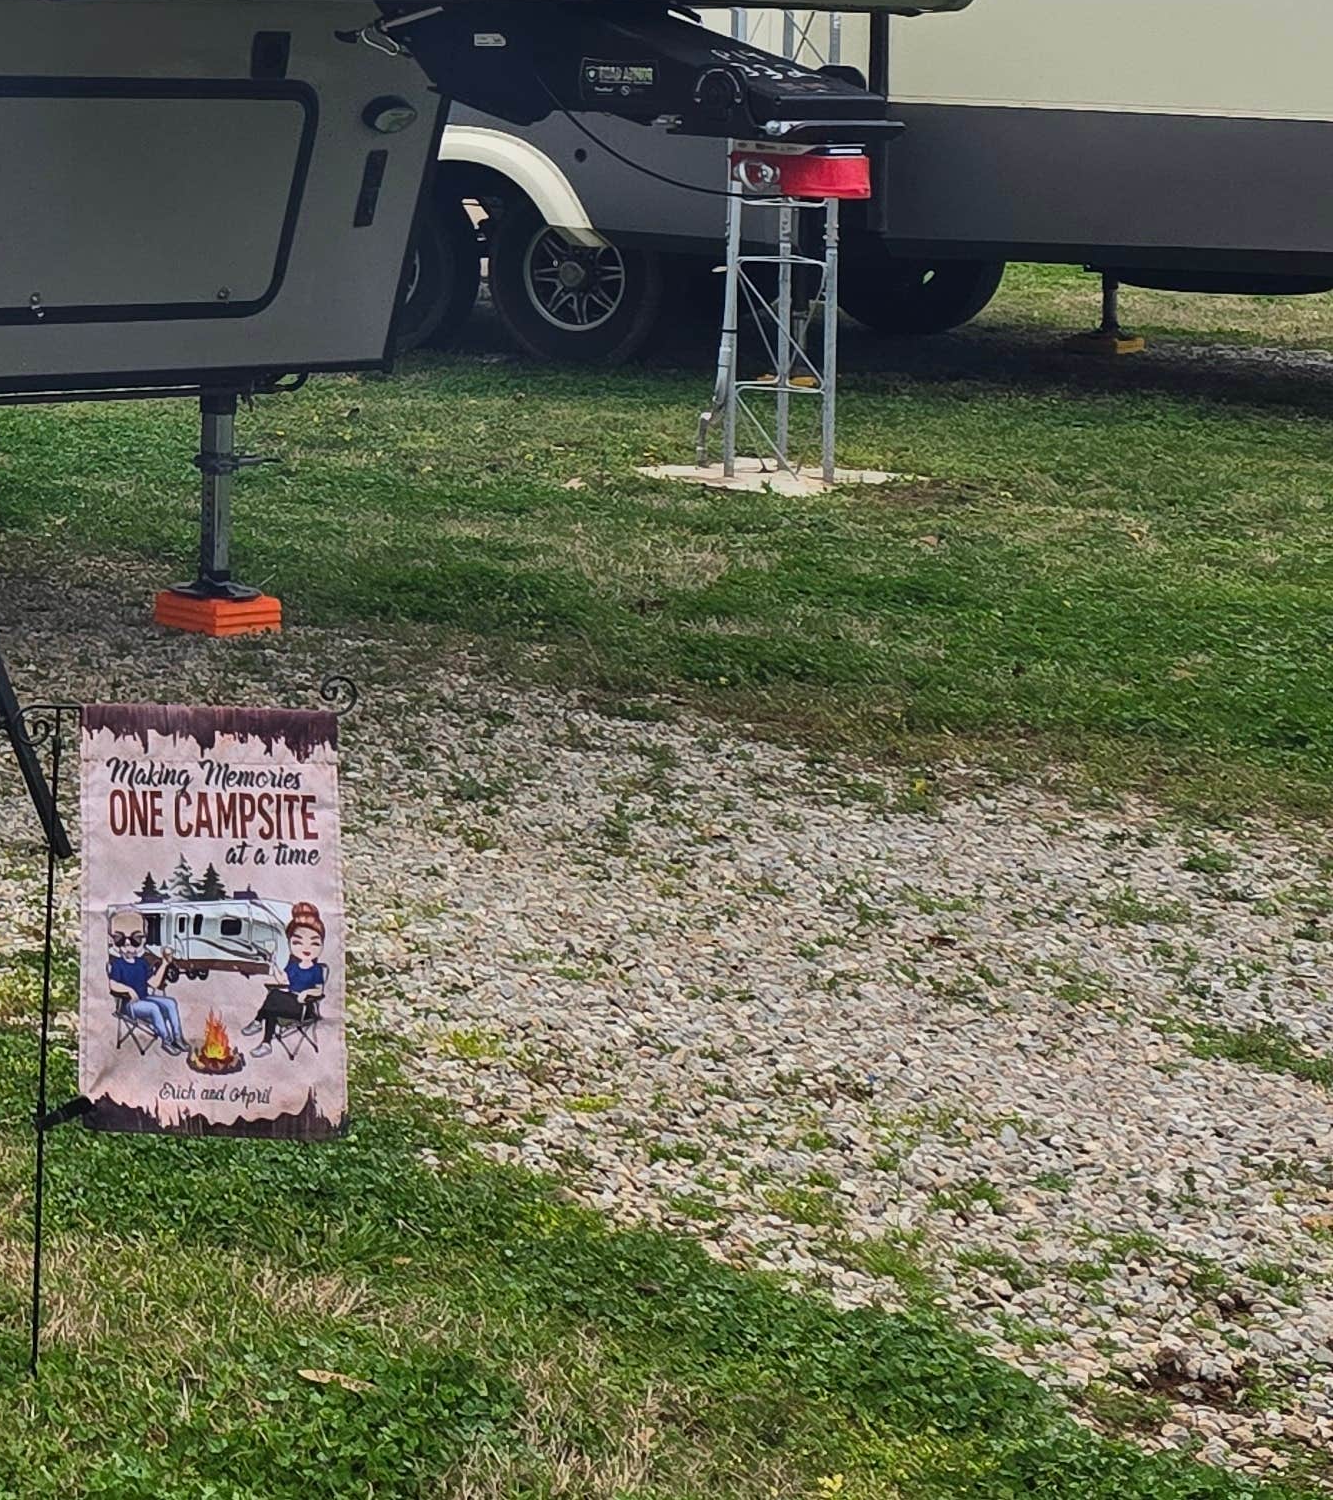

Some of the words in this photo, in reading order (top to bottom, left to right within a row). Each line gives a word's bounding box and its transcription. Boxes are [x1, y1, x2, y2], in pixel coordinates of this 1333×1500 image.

[105, 756, 194, 797] Making
[198, 758, 302, 793] Memories
[109, 788, 164, 838] ONE
[174, 790, 320, 841] CAMPSITE
[225, 841, 252, 866] at
[254, 851, 269, 866] a
[273, 842, 322, 867] time
[200, 1083, 228, 1101] and
[229, 1086, 273, 1109] April
